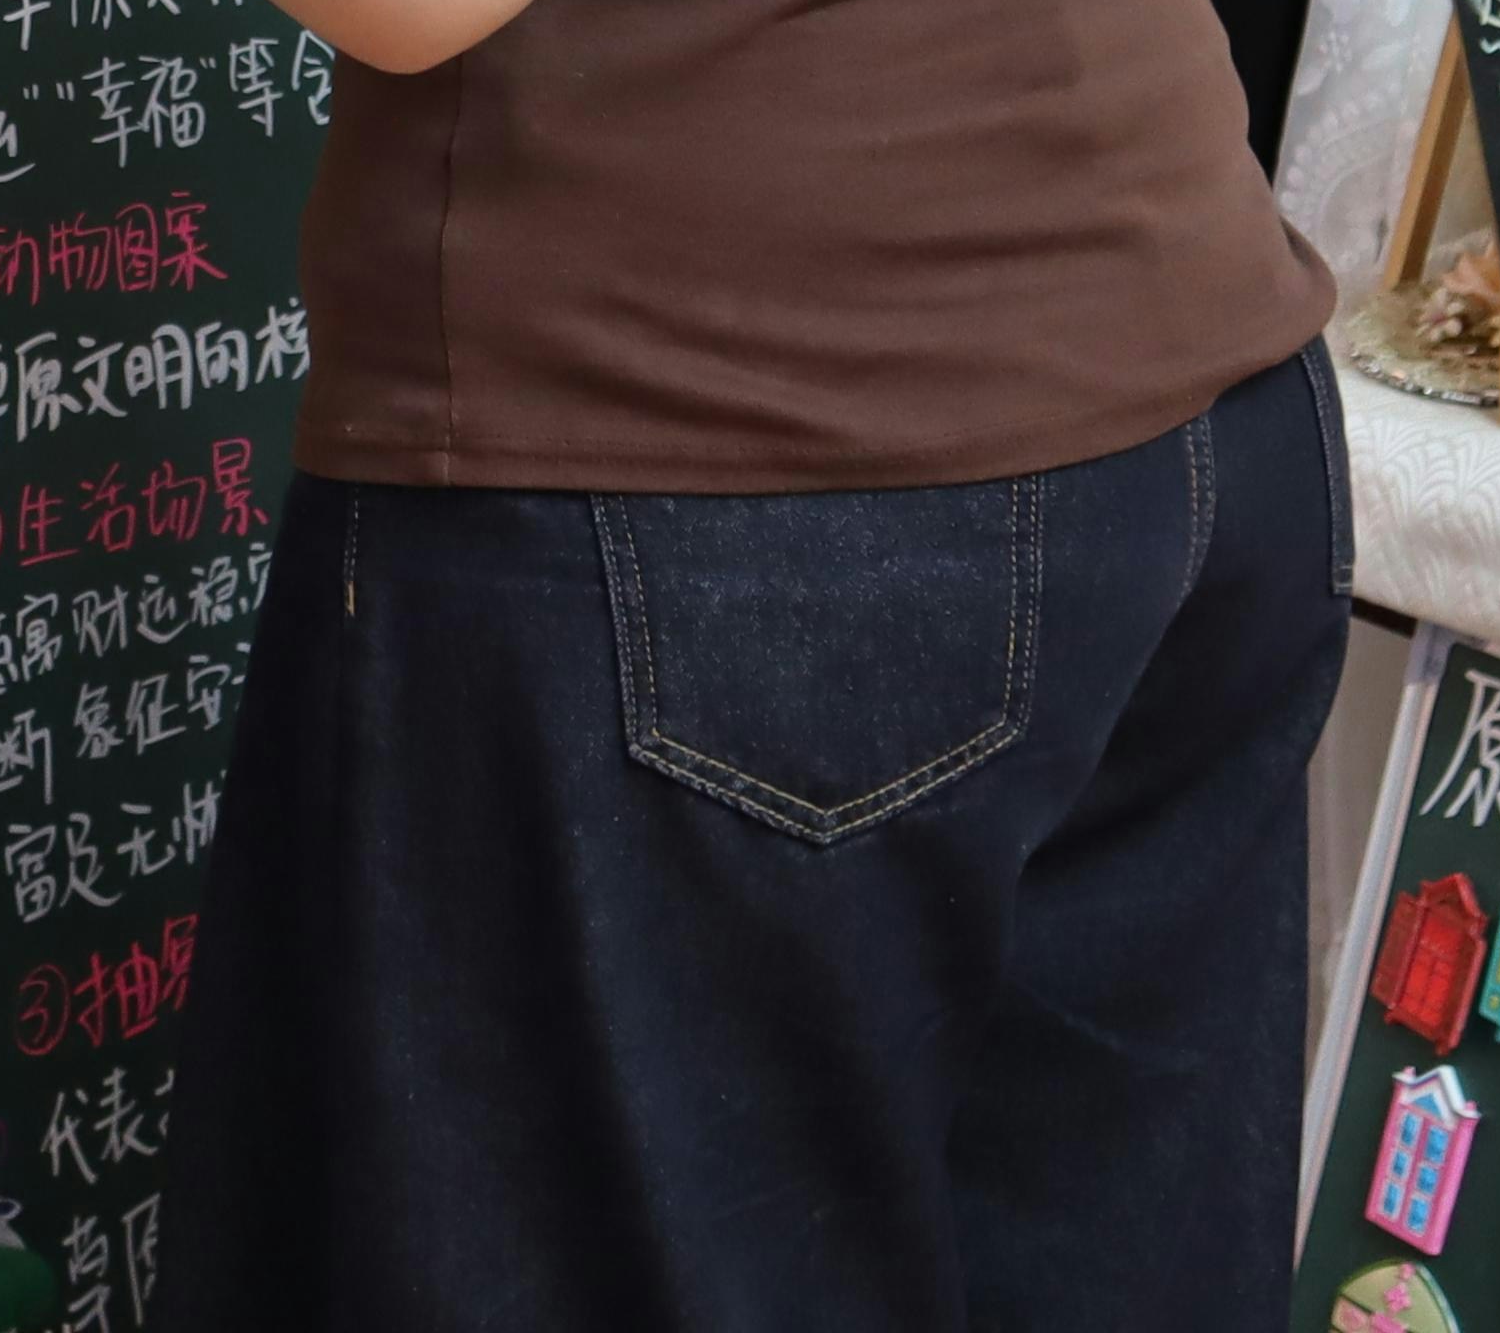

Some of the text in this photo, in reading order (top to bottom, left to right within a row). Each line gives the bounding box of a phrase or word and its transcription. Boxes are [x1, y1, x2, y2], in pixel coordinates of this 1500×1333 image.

[72, 639, 250, 757] 象征安
[41, 1067, 176, 1185] 代表
